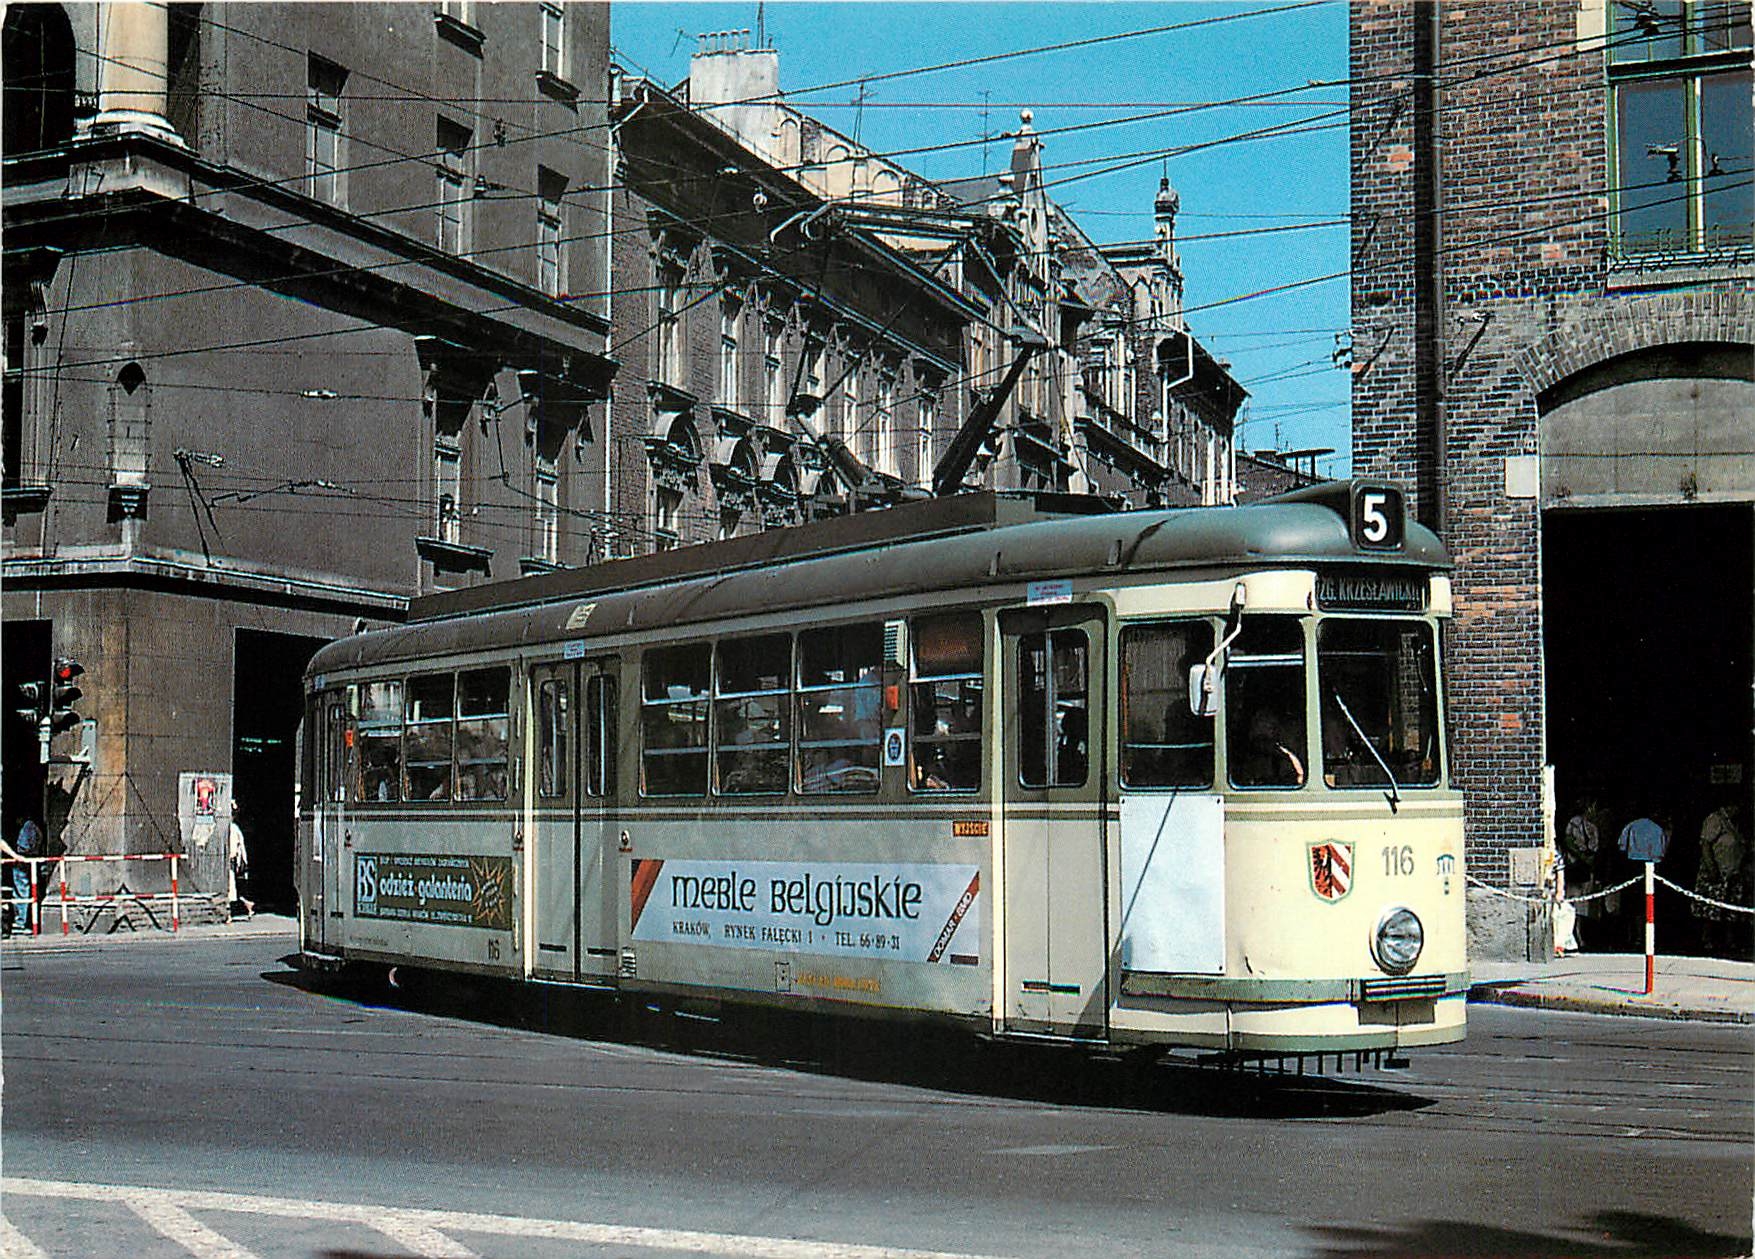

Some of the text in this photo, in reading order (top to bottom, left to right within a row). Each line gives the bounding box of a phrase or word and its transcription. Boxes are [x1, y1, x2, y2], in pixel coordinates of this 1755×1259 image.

[1363, 493, 1388, 542] 5
[1381, 845, 1415, 876] 116
[418, 873, 472, 905] galanteria
[673, 920, 711, 939] KRAKÓW,
[724, 923, 756, 941] RYNEK
[762, 926, 802, 946] FAŁĘCKI
[836, 931, 856, 948] TEL.
